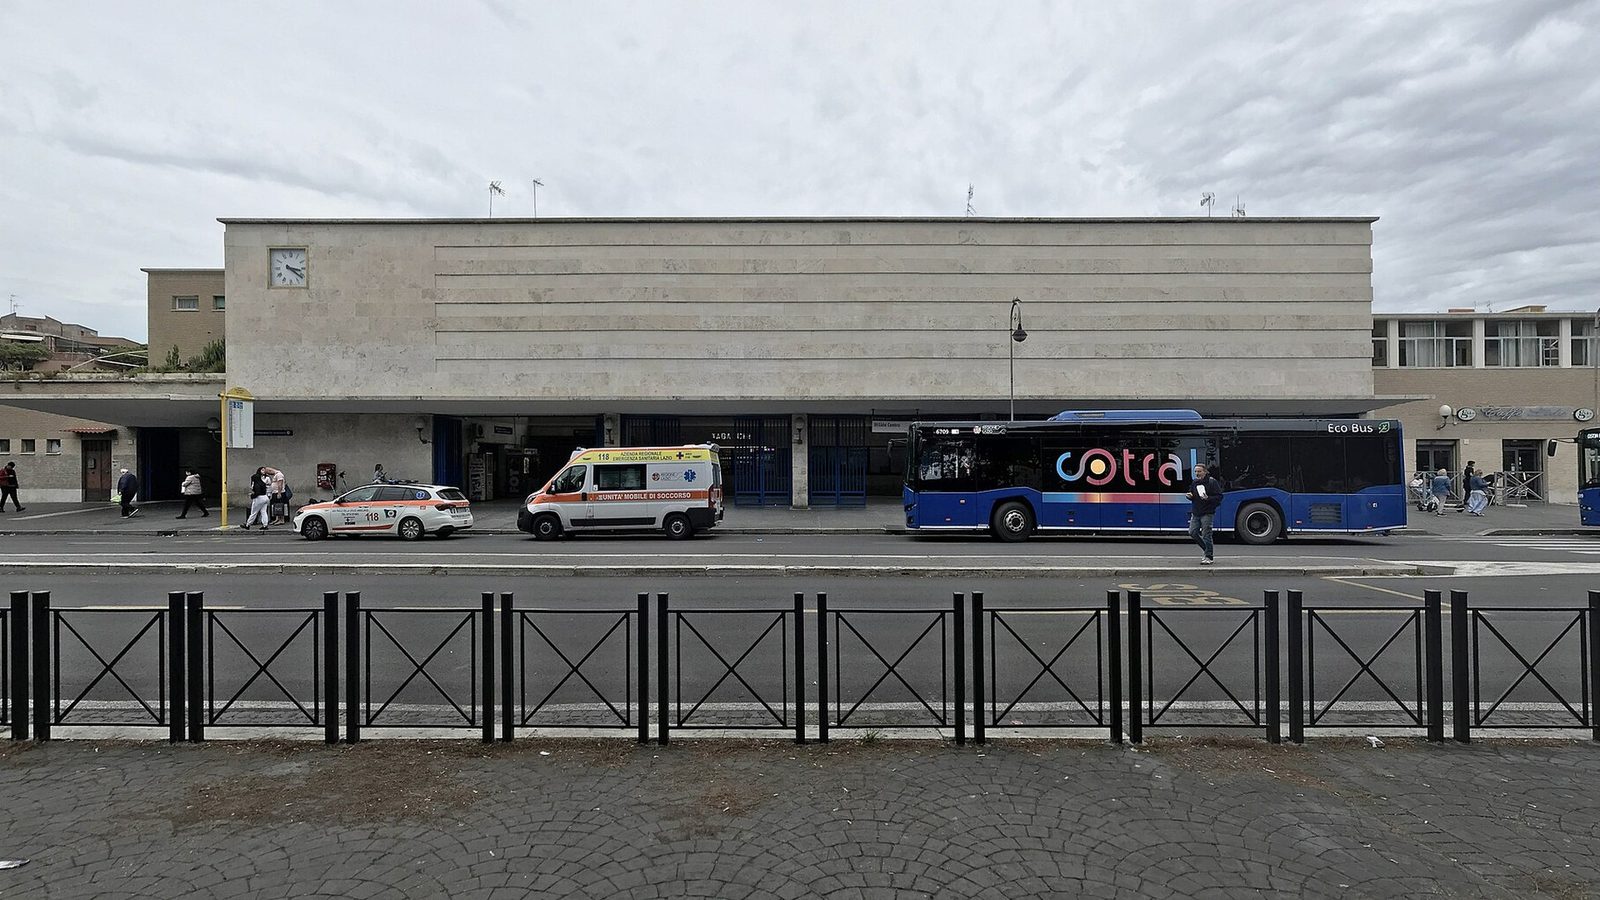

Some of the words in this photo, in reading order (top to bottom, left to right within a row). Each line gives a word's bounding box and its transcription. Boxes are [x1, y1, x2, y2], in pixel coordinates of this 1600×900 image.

[1328, 423, 1348, 433] Eco
[1351, 423, 1374, 433] Bus
[598, 453, 610, 461] 118
[1056, 448, 1197, 486] cotral
[366, 513, 380, 521] 118
